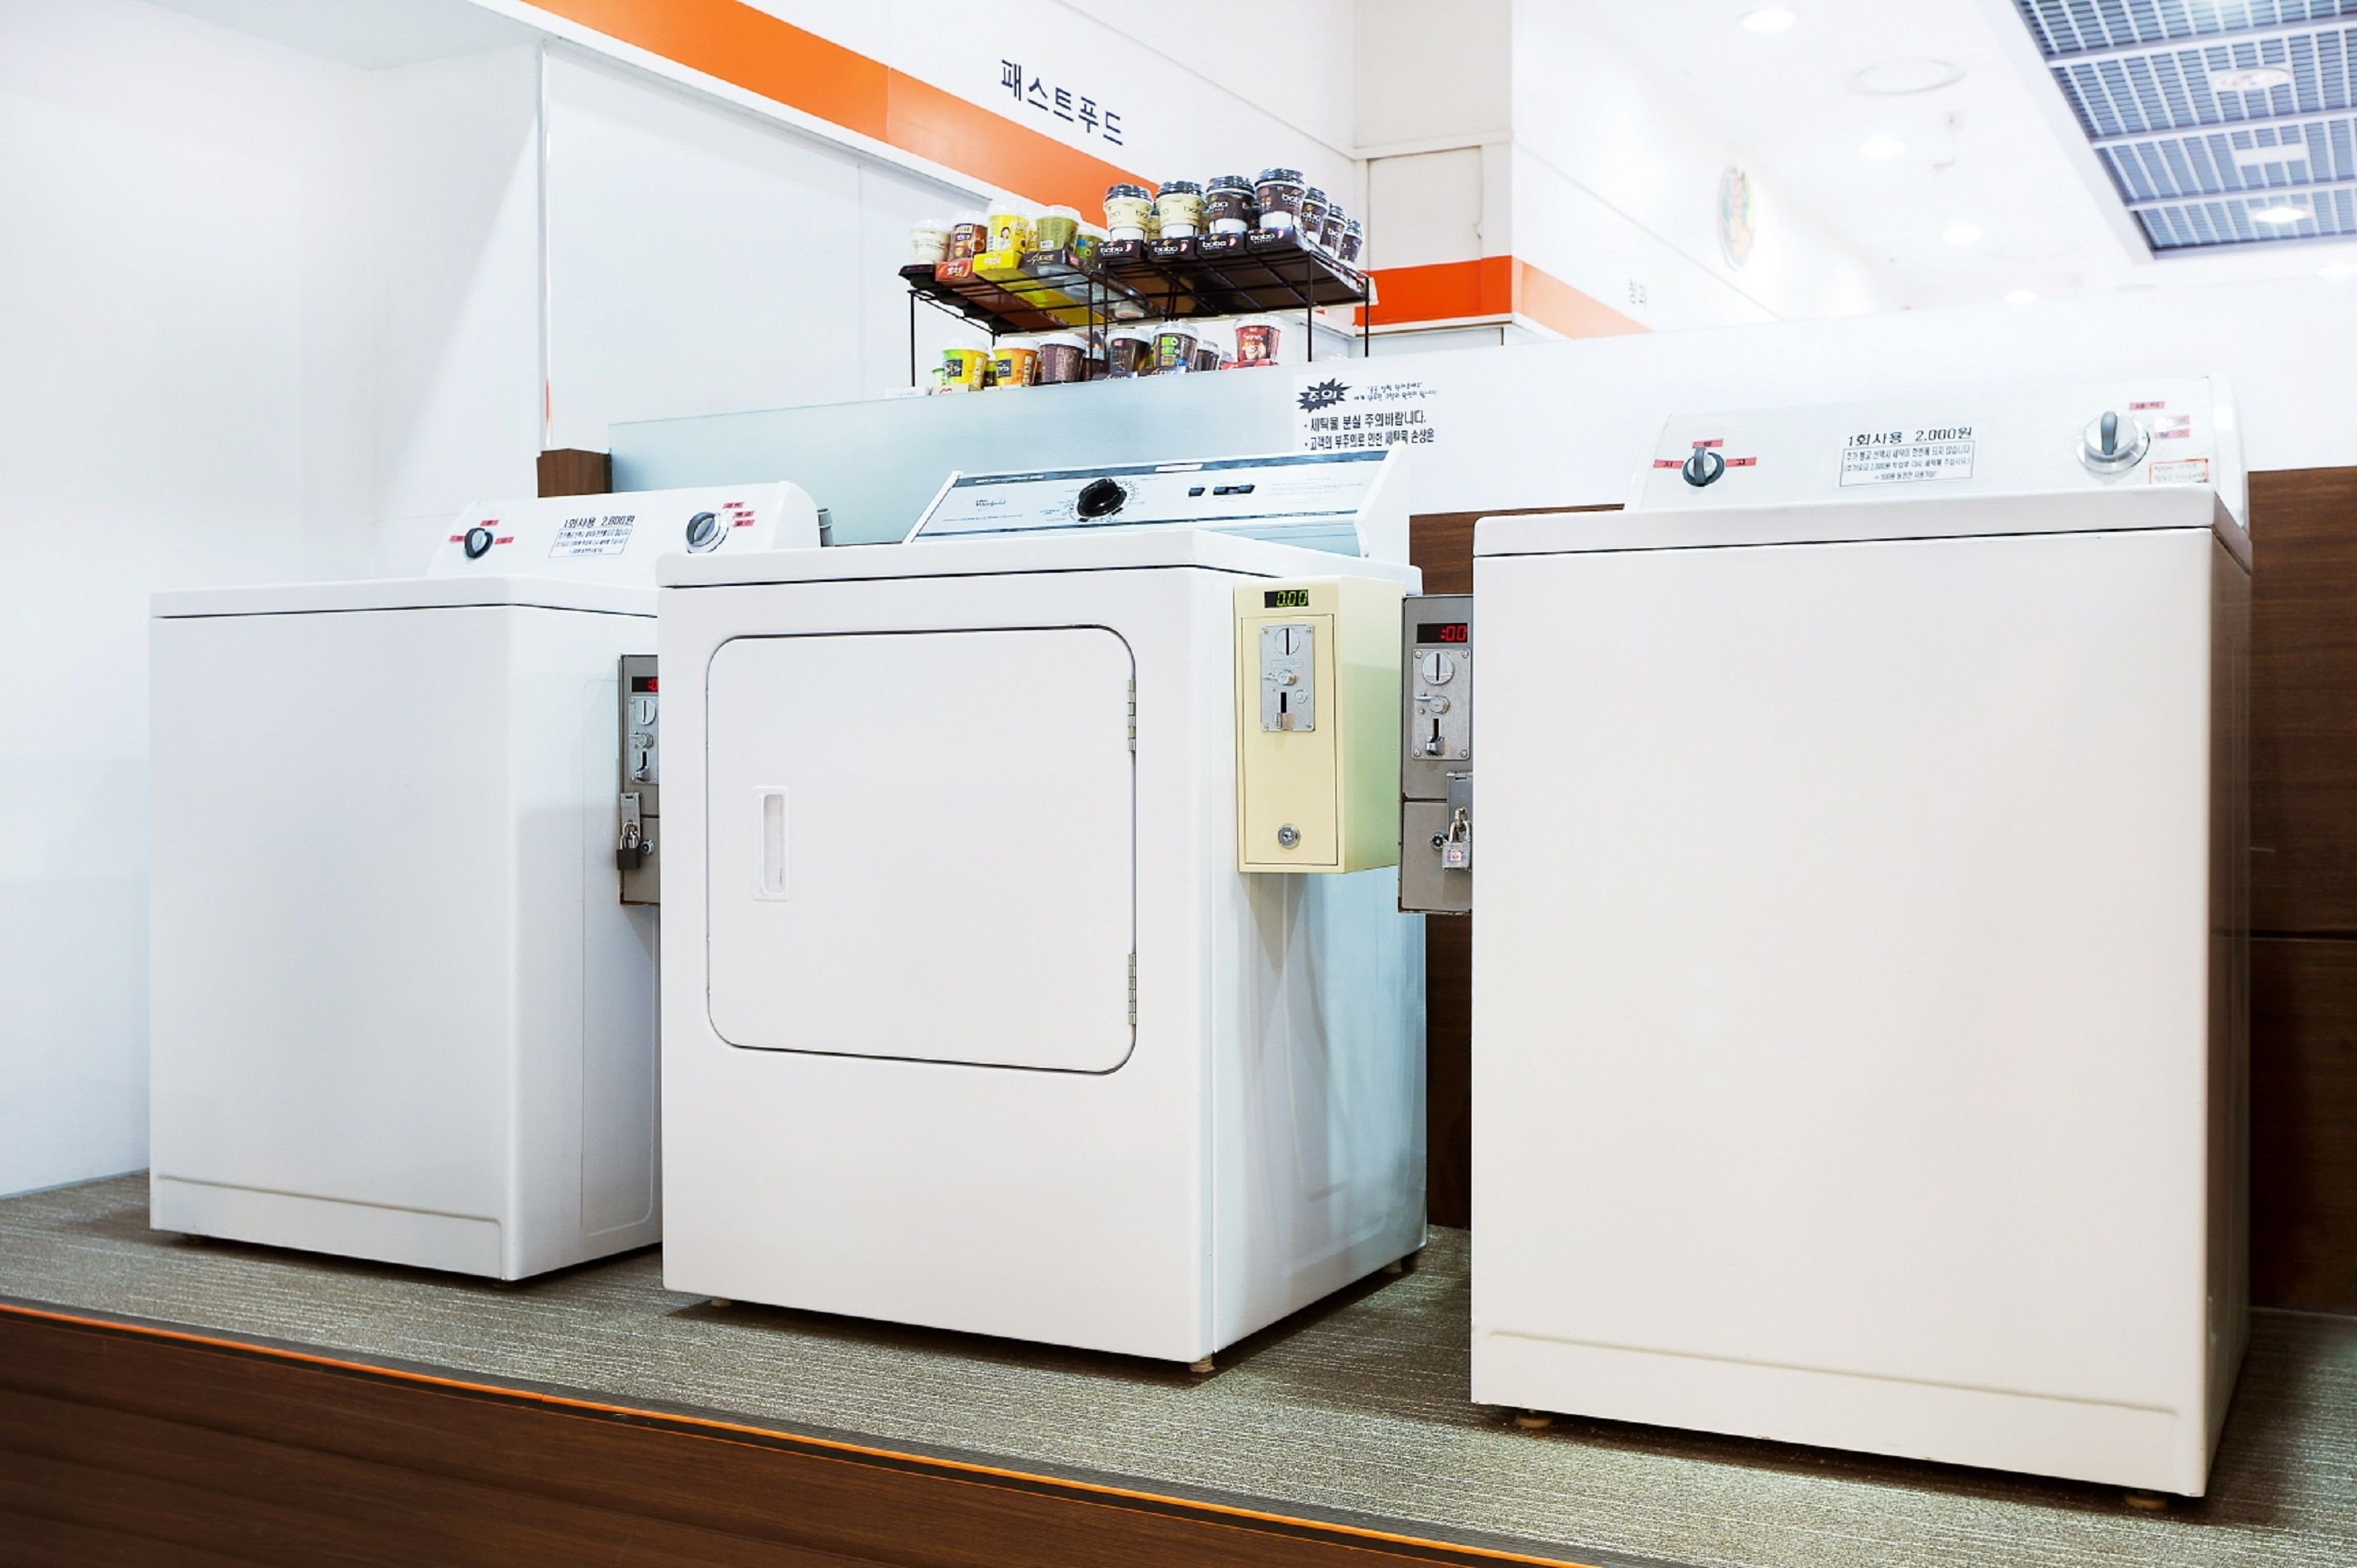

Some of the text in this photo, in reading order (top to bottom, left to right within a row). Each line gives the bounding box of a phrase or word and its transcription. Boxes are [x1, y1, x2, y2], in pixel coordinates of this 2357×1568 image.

[1001, 59, 1123, 146] 패스트푸드
[1308, 389, 1338, 403] 주의
[1310, 417, 1339, 432] 세탁물
[1343, 414, 1361, 430] 분실
[1310, 435, 1332, 451] 고객의
[1335, 432, 1365, 448] 부주의로
[1848, 431, 1903, 446] 1회사용
